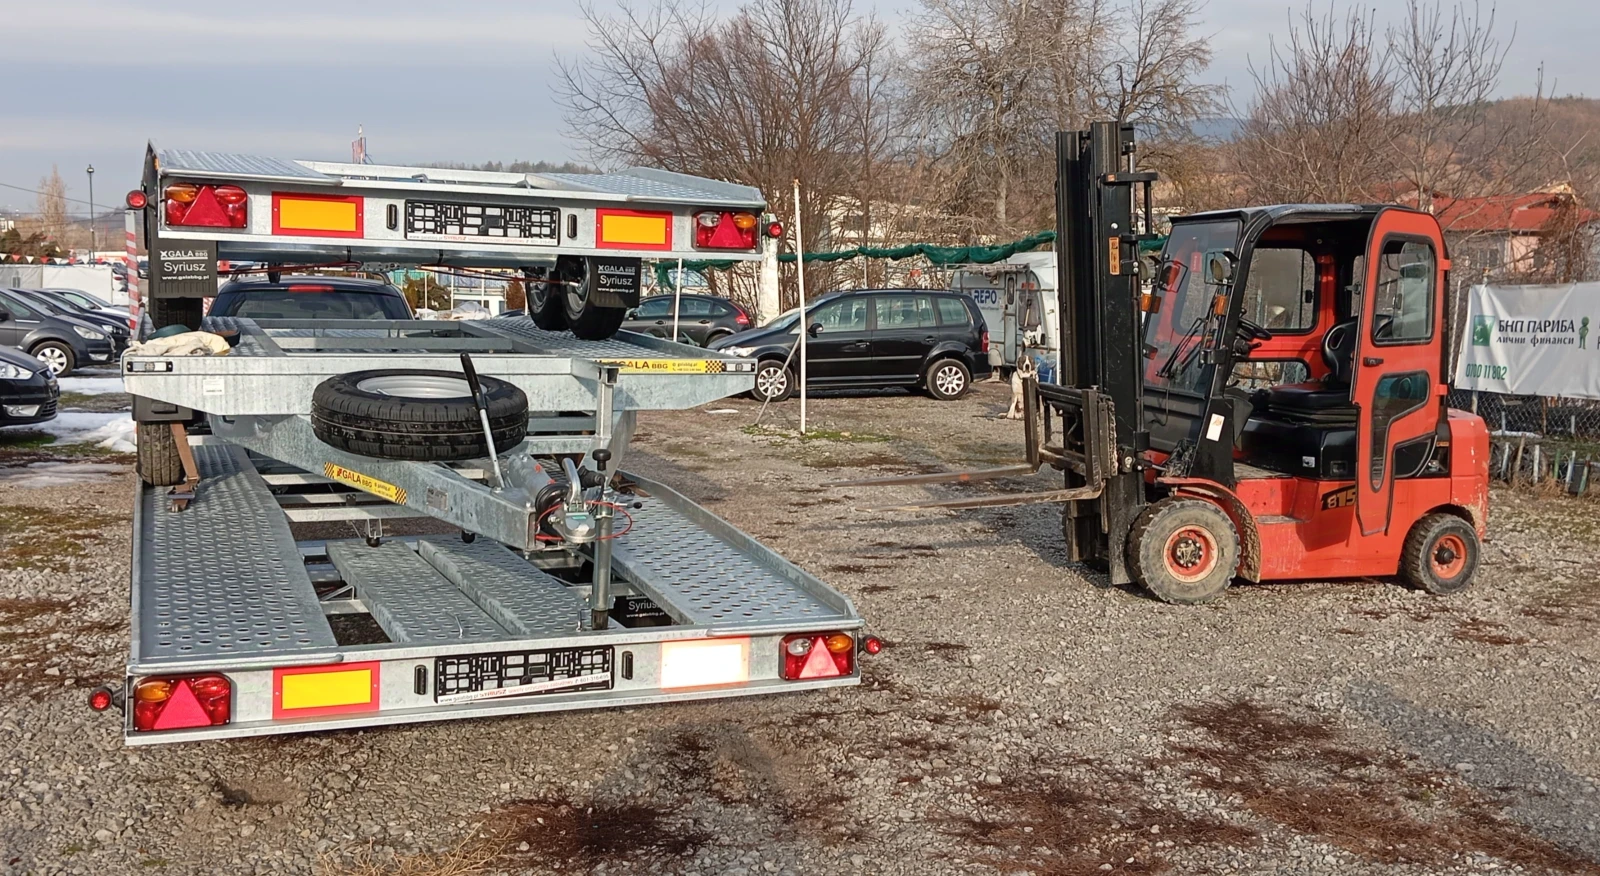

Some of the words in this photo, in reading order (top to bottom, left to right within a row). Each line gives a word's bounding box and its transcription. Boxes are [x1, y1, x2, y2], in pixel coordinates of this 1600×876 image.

[164, 261, 206, 274] Syriusz
[600, 275, 633, 287] Syriusz
[1498, 319, 1524, 333] БНП
[1526, 319, 1575, 334] ПАРИБА
[1496, 336, 1526, 344] лични
[1530, 334, 1574, 347] финанси
[1465, 363, 1483, 378] 0700
[1491, 364, 1508, 381] 802
[628, 599, 661, 612] Syrius
